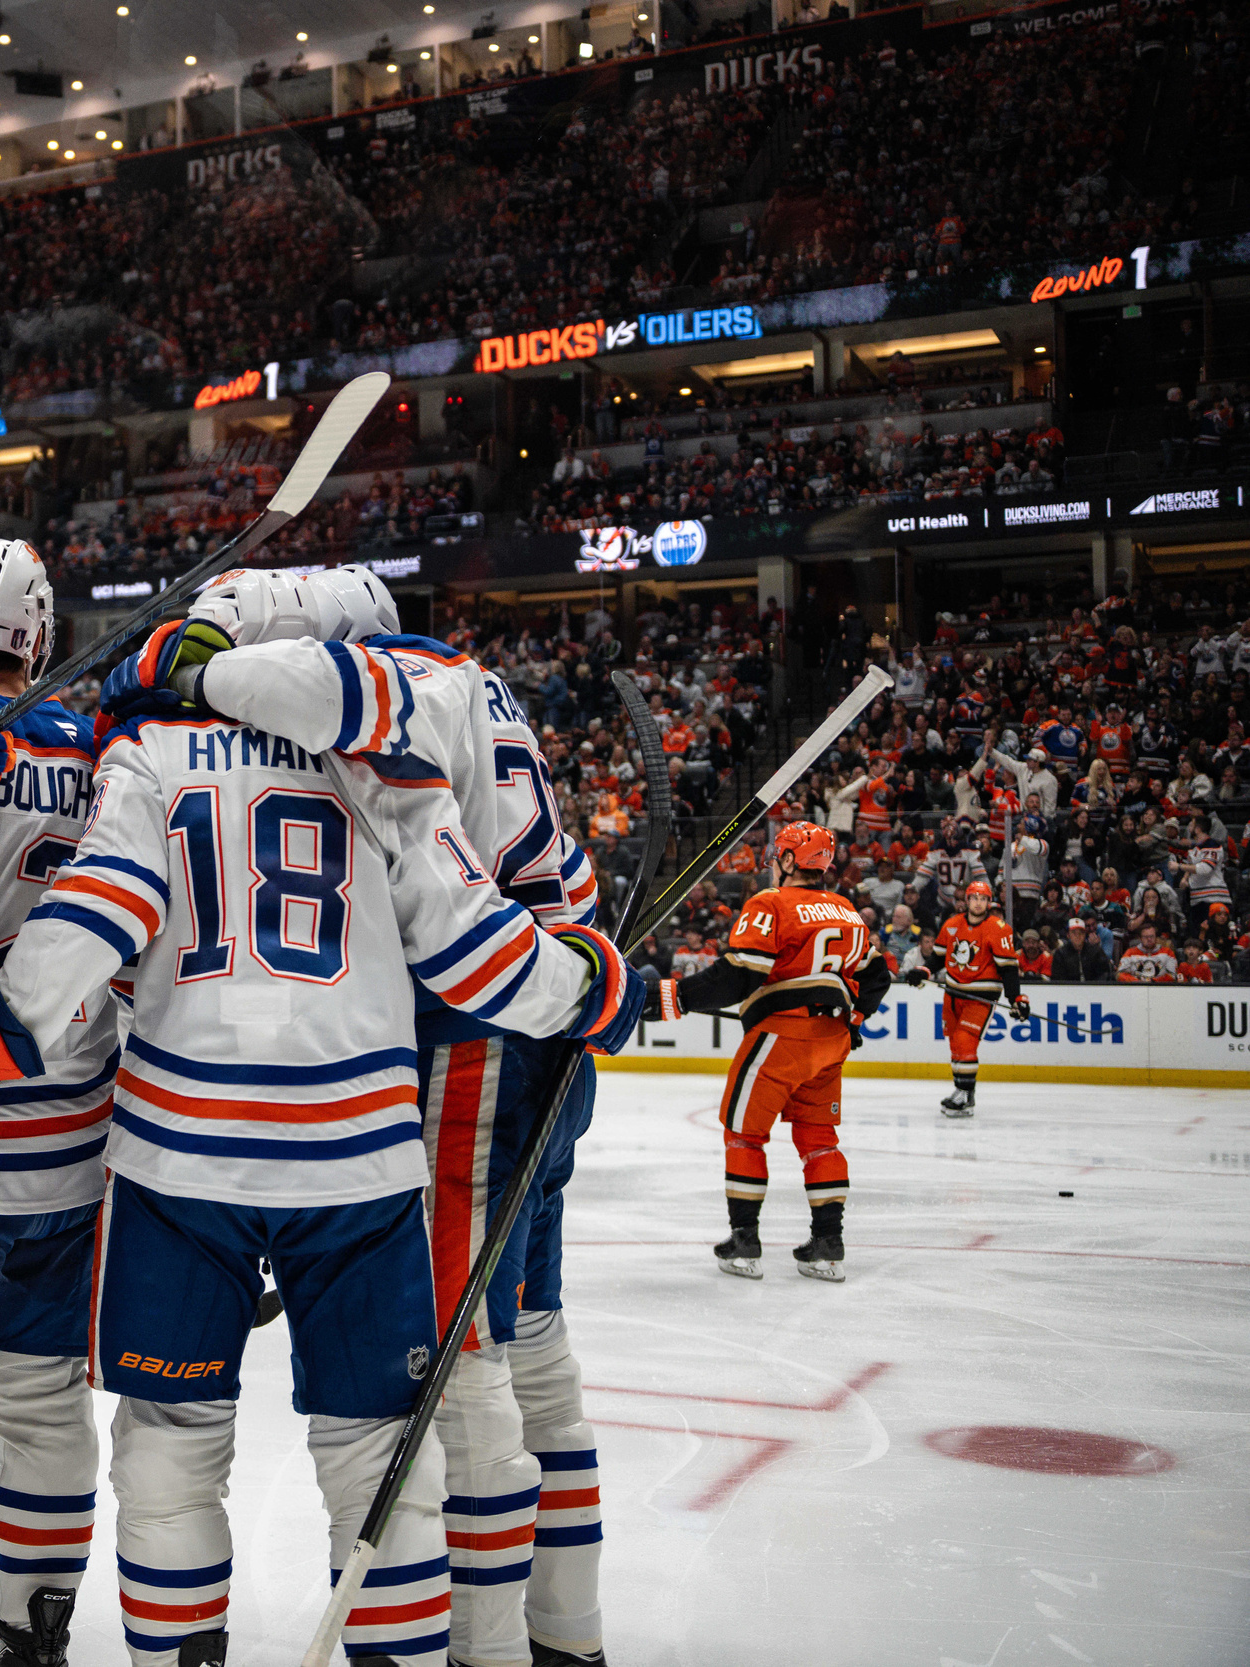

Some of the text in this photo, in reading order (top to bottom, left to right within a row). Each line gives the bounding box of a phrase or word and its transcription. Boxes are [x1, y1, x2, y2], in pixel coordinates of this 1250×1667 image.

[1014, 3, 1119, 34] WELCOME
[703, 44, 826, 95] DUCKS
[187, 144, 283, 188] DUCKS
[1031, 246, 1150, 303] ROUND 1
[481, 305, 753, 373] DUCKS VS OILERS
[195, 362, 280, 409] ROUND 1
[1004, 501, 1090, 521] DUCKSLIVING.COM
[1156, 489, 1219, 504] MERCURY
[1157, 498, 1219, 513] INSURANCE
[888, 513, 969, 532] UCI Health
[188, 727, 324, 774] HYMAN
[717, 821, 739, 846] ALPHA
[435, 826, 490, 887] 1
[166, 784, 354, 987] 18
[937, 860, 968, 886] 97
[735, 911, 774, 938] 64
[857, 1001, 909, 1041] CI
[1207, 1001, 1250, 1038] DU
[117, 1351, 226, 1380] BAUER
[402, 1412, 417, 1440] HYMAN
[43, 1593, 72, 1601] CCM
